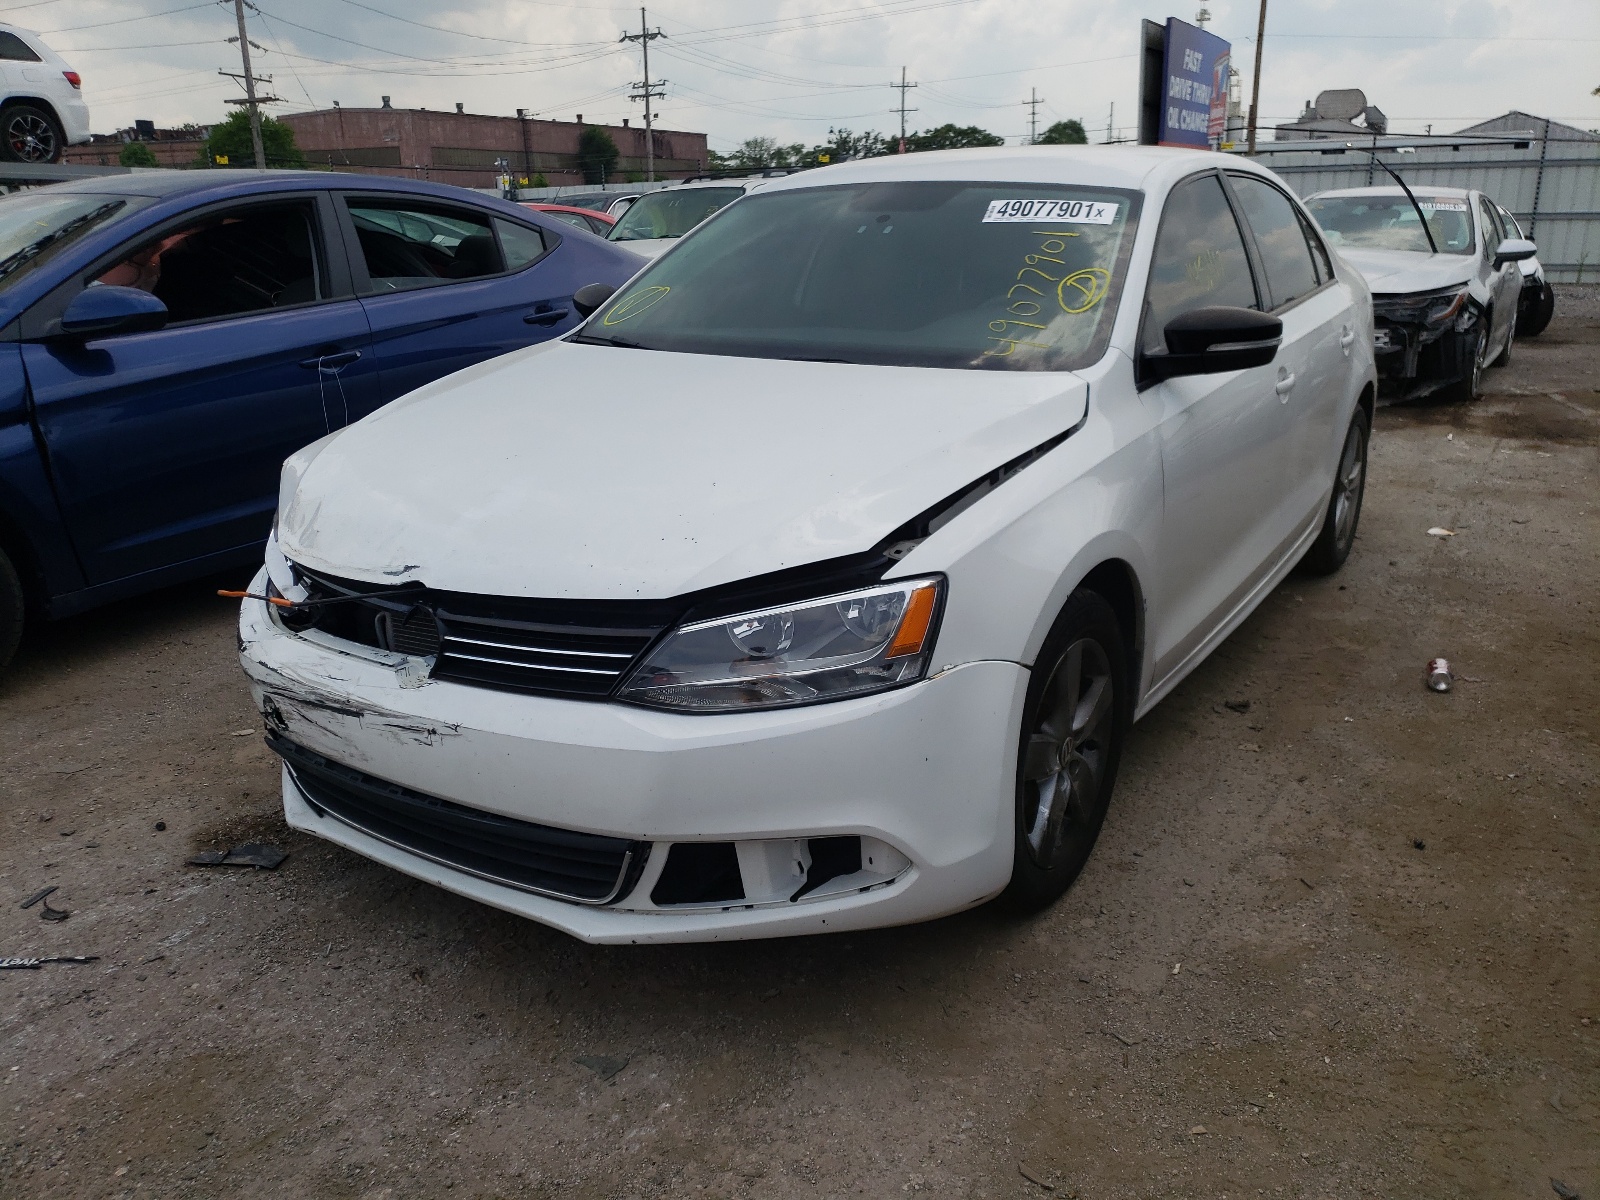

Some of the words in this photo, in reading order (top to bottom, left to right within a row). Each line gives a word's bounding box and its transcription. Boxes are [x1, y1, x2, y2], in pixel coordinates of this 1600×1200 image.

[1183, 49, 1203, 73] FAST
[1169, 75, 1192, 100] DRIVE
[1192, 82, 1212, 105] THRU
[1168, 106, 1179, 129] OIL
[1180, 109, 1210, 133] CHANGE
